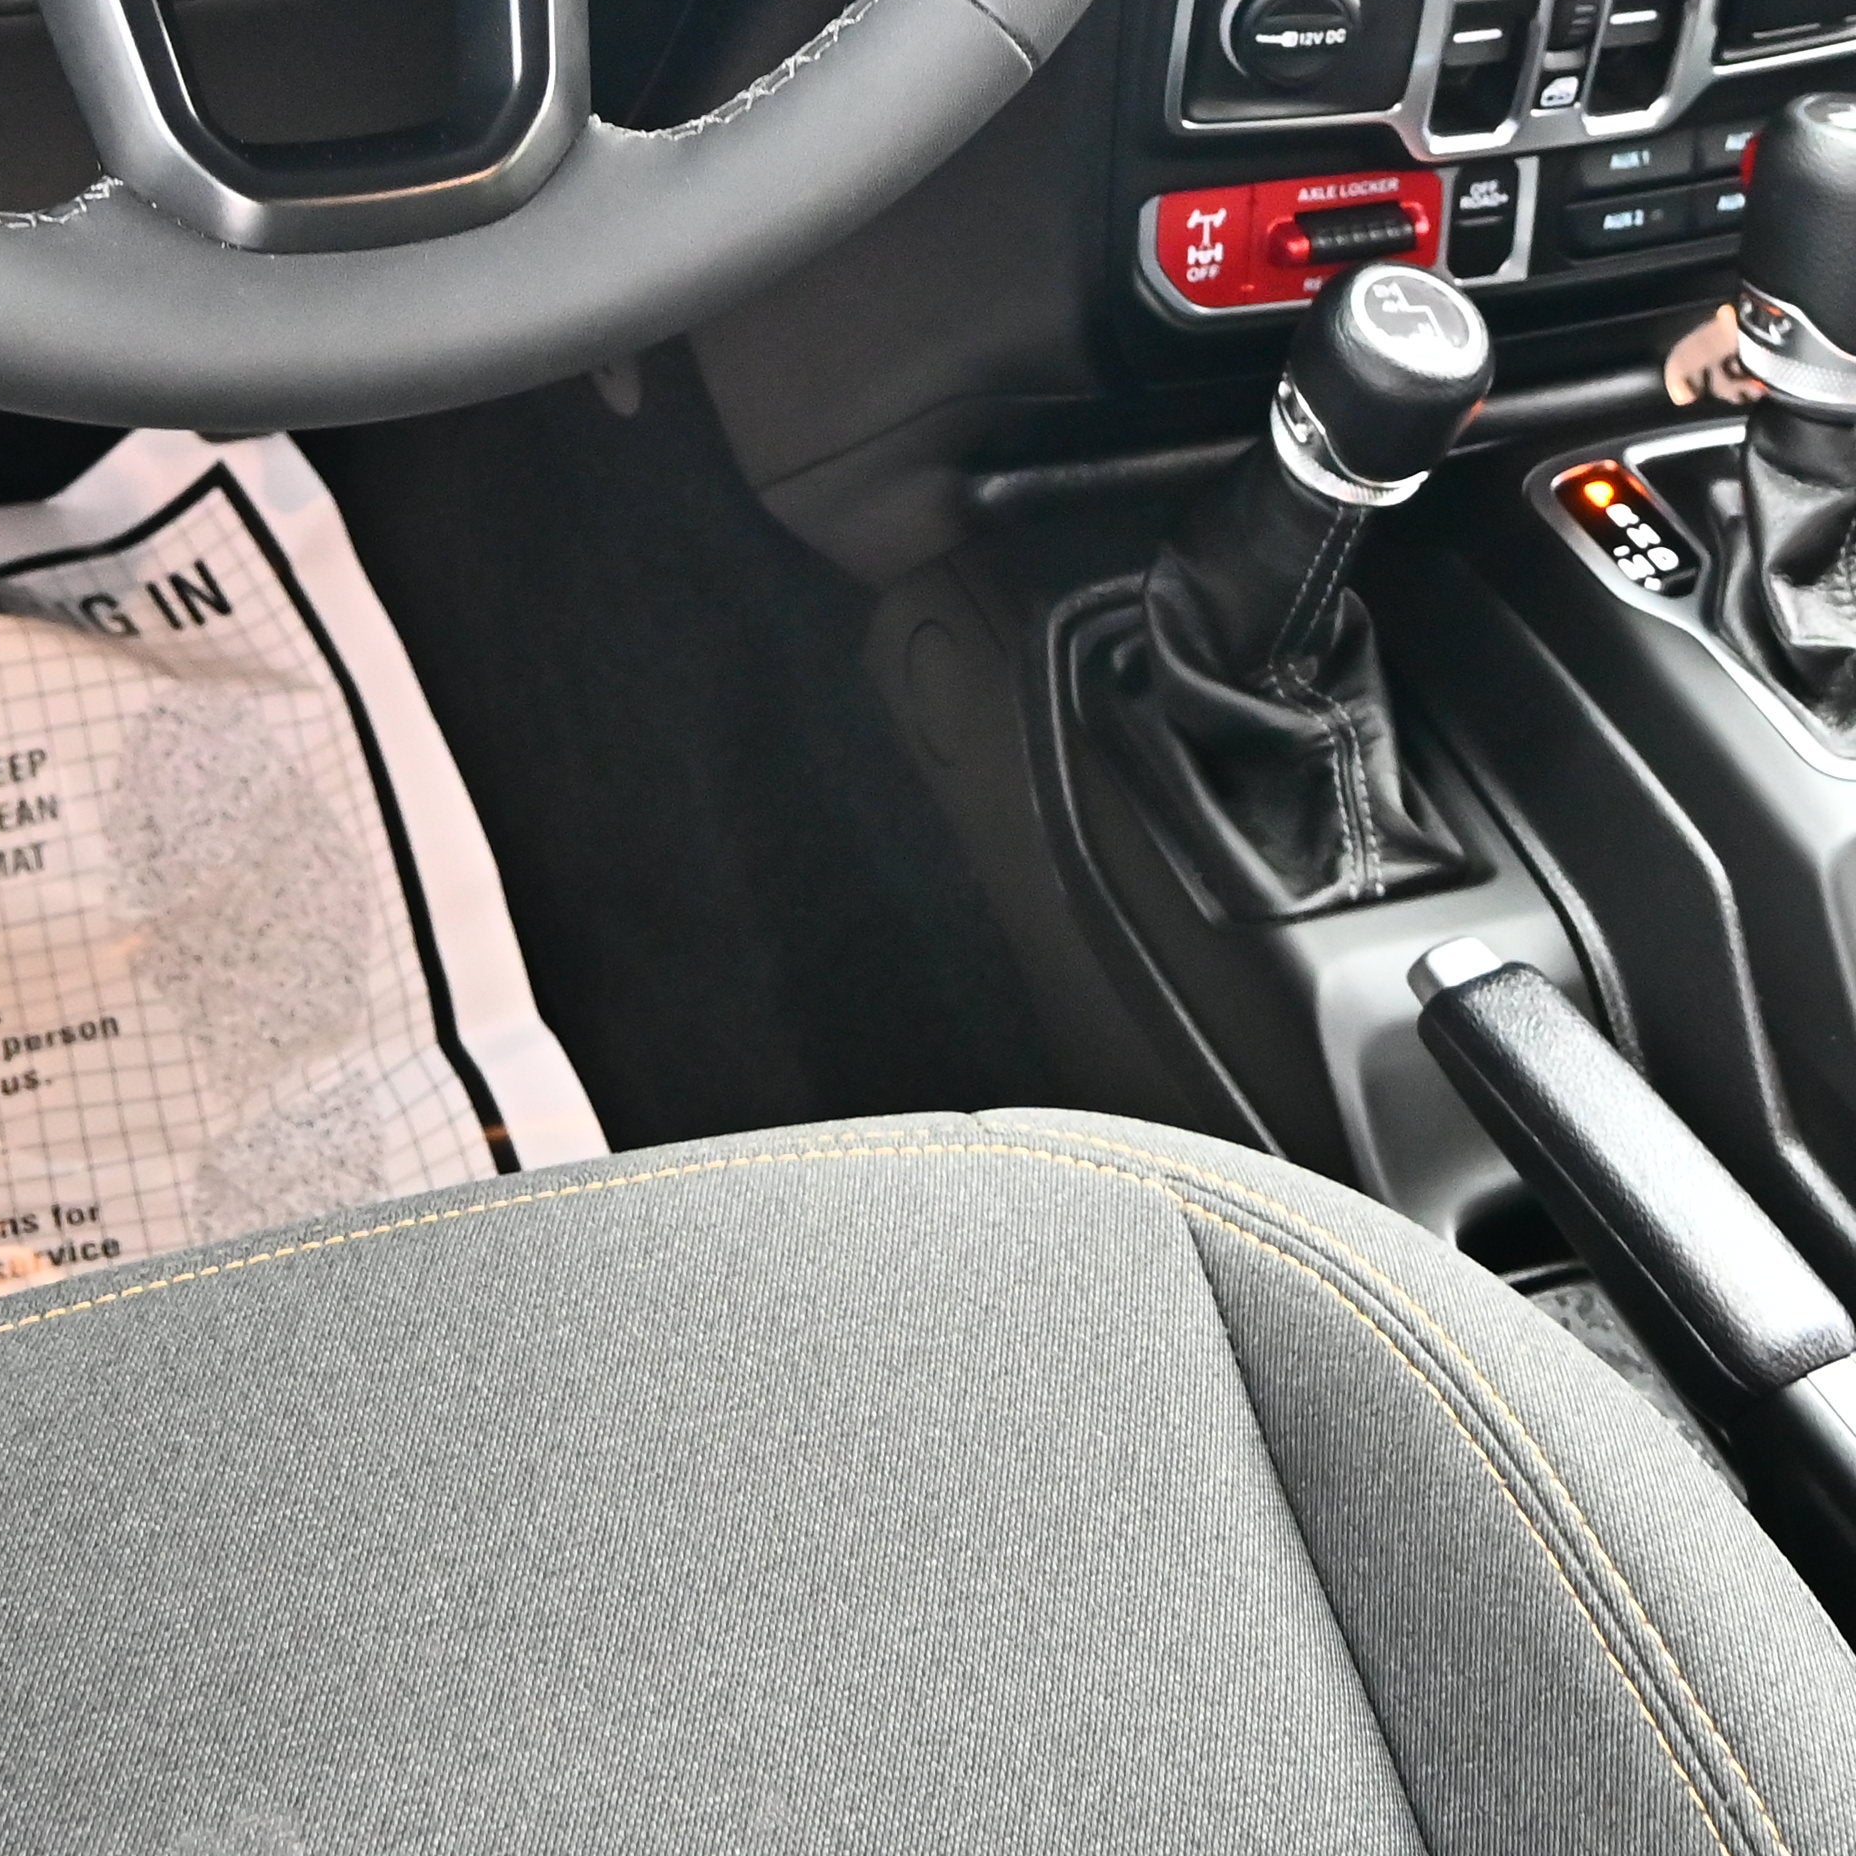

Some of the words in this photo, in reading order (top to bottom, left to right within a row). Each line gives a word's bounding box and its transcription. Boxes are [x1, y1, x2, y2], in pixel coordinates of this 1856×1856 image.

[1299, 30, 1324, 47] 12V
[1297, 185, 1336, 203] AXLE
[1339, 177, 1400, 198] LOCKER
[1470, 179, 1499, 195] OFF
[1186, 263, 1221, 283] OFF
[146, 557, 233, 632] IN
[1, 1013, 121, 1064] person
[0, 1068, 54, 1098] us.
[50, 1202, 103, 1232] for
